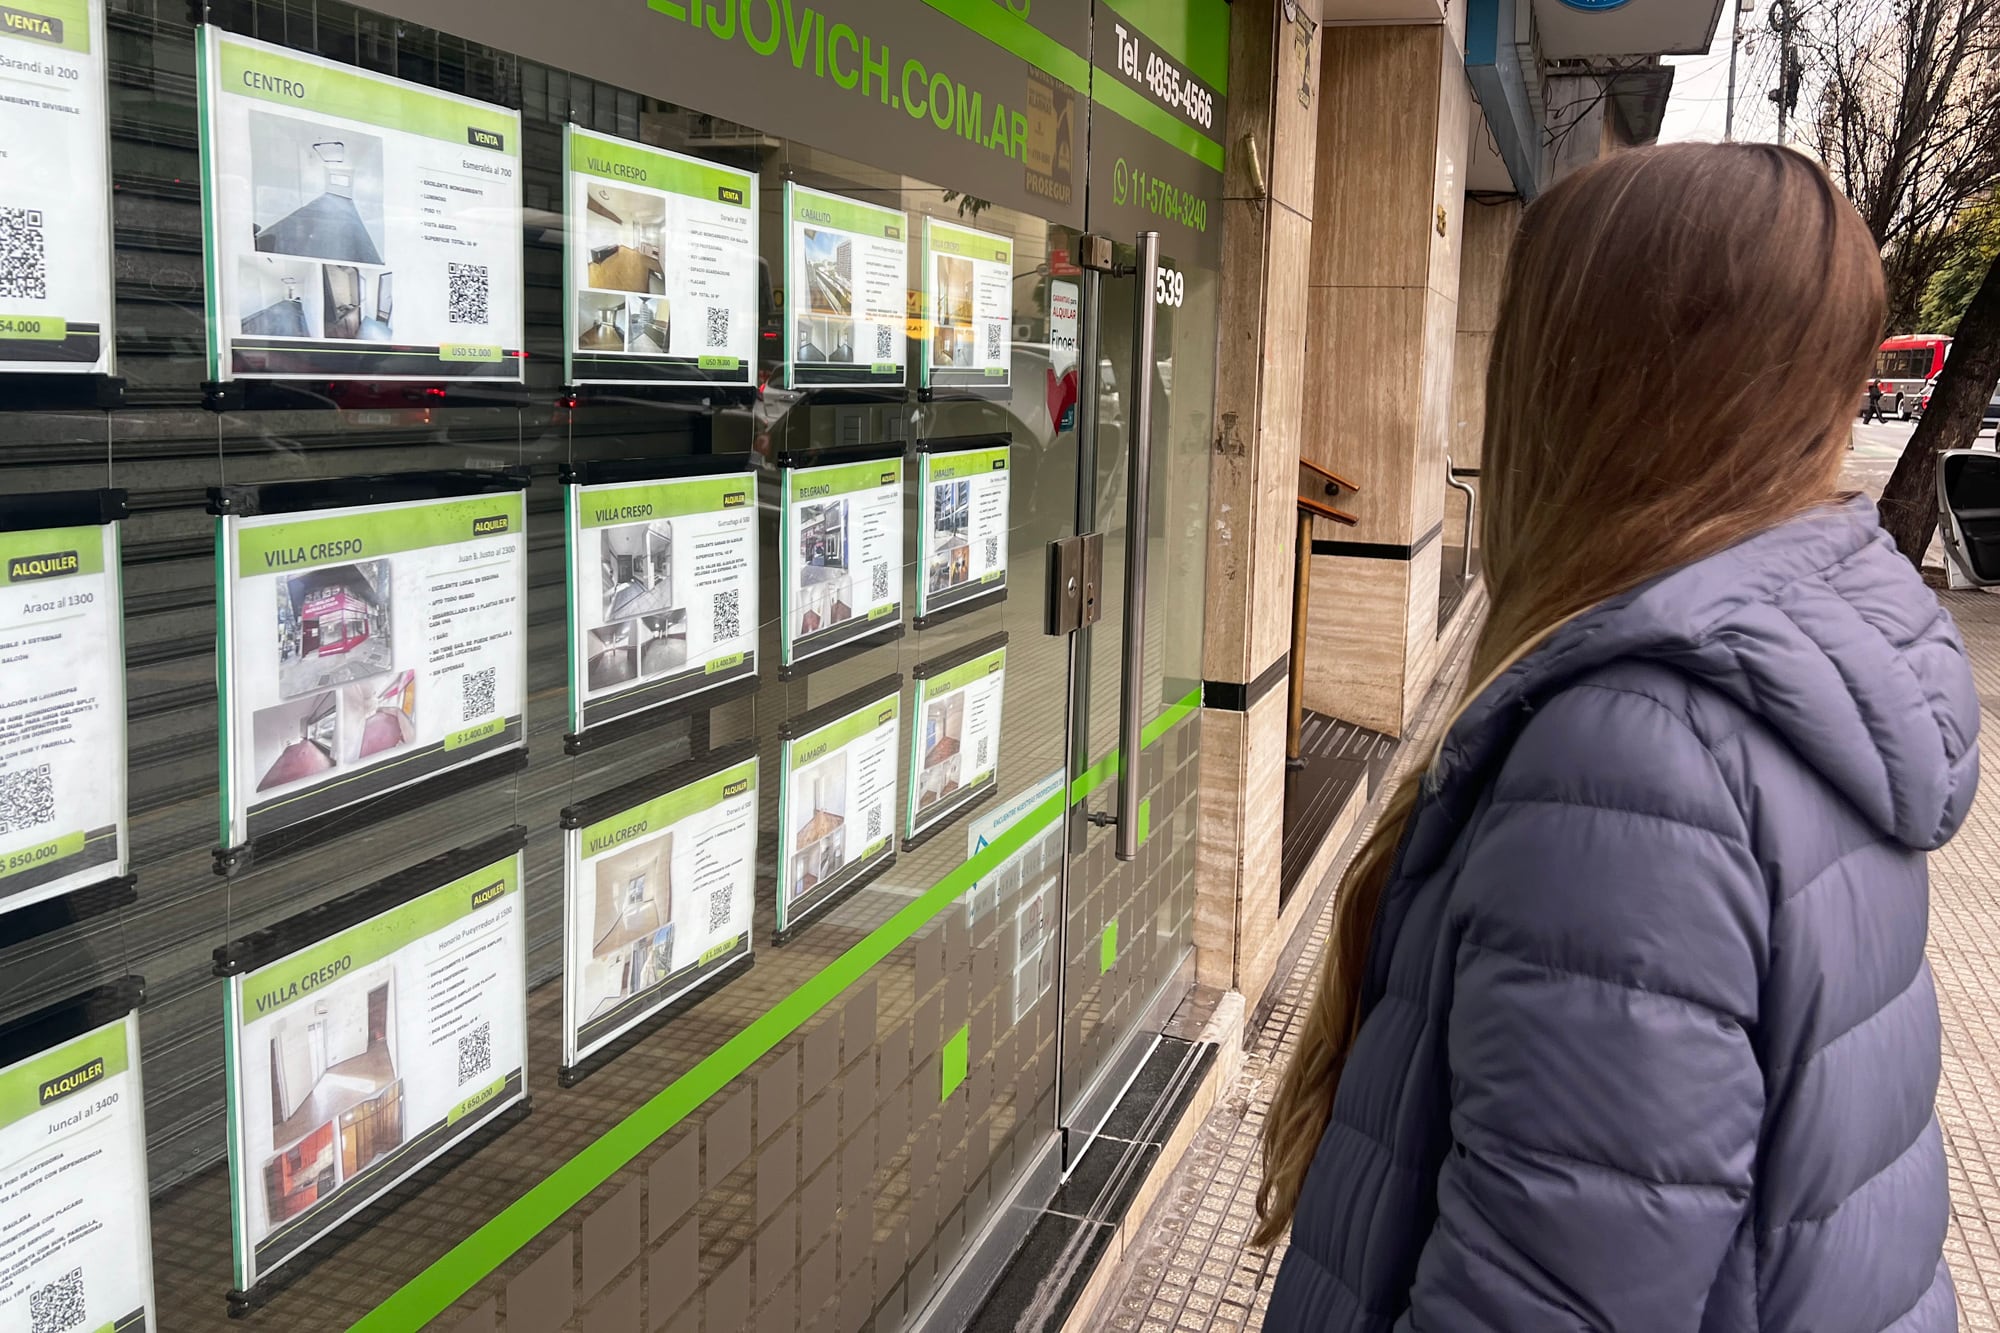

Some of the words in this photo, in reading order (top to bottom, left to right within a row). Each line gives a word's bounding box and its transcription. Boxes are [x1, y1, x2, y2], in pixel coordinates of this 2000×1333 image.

[4, 12, 52, 36] VENTA
[44, 65, 54, 76] al
[57, 67, 79, 80] 200
[243, 69, 305, 99] CENTRO
[1115, 23, 1142, 83] Tel.
[1146, 52, 1213, 129] 4855-4566
[474, 131, 499, 147] VENTA
[462, 159, 493, 175] Esmeralda
[500, 167, 512, 177] 700
[587, 157, 611, 174] VILLA
[613, 163, 647, 182] CRESPO
[722, 190, 739, 201] VENTA
[1026, 171, 1072, 204] PROSEGUR
[1132, 168, 1208, 233] 11-5764-3240
[1156, 266, 1184, 308] 539
[1052, 306, 1077, 320] ALQUILAR
[452, 347, 466, 356] USD
[724, 494, 745, 504] ALQUILER
[800, 484, 830, 498] BELGRANO
[475, 518, 508, 532] ALQUILER
[595, 508, 619, 523] VILLA
[621, 504, 653, 519] CRESPO
[264, 547, 307, 567] VILLA
[310, 538, 362, 560] CRESPO
[12, 555, 77, 577] ALQUILER
[23, 602, 55, 615] Araoz
[57, 597, 66, 608] al
[68, 592, 94, 607] 1300
[457, 734, 462, 744] $
[800, 743, 827, 764] ALMAGRO
[724, 781, 747, 796] ALQUILER
[590, 836, 615, 853] VILLA
[616, 820, 648, 842] CRESPO
[9, 844, 58, 869] 850.000
[473, 882, 504, 906] ALQUILER
[256, 982, 298, 1012] VILLA
[301, 955, 351, 991] CRESPO
[43, 1063, 102, 1100] ALQUILER
[461, 1103, 466, 1113] $
[467, 1087, 493, 1109] 650.000
[48, 1111, 82, 1135] Juncal
[85, 1106, 93, 1118] al
[95, 1092, 119, 1113] 3400
